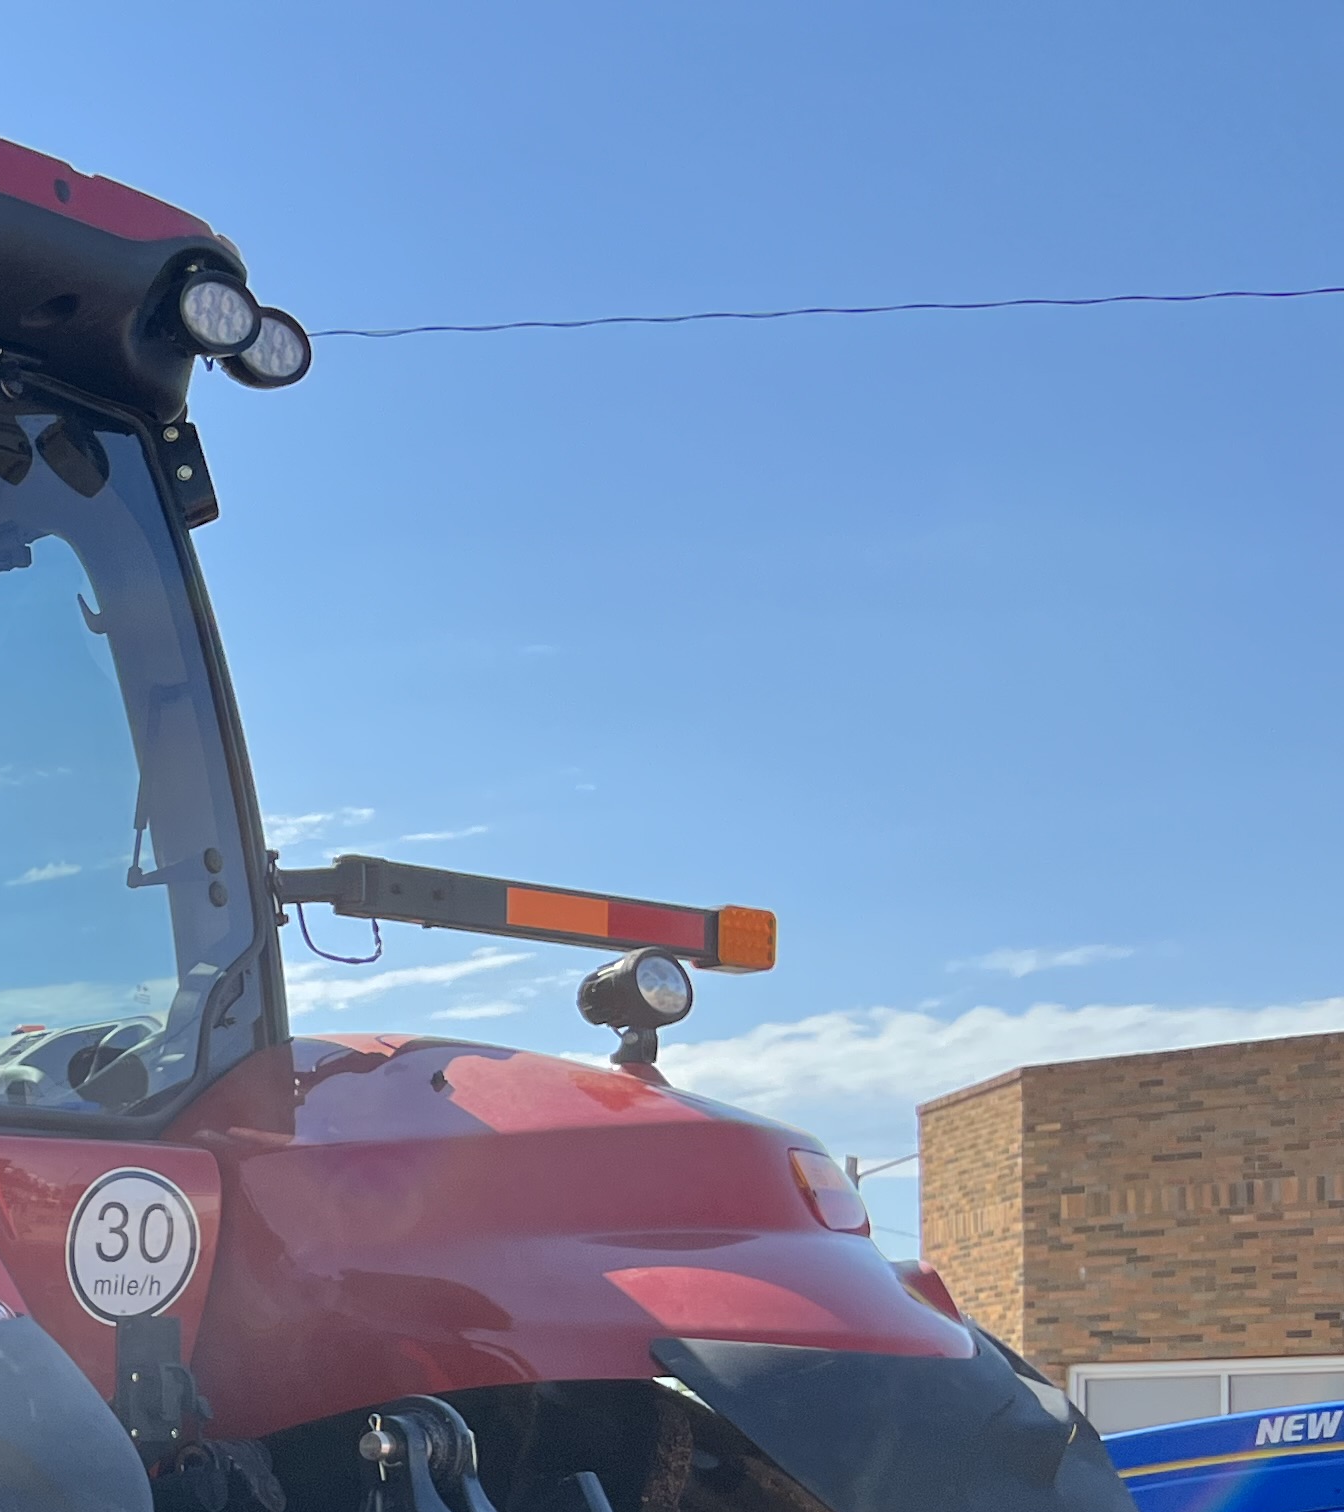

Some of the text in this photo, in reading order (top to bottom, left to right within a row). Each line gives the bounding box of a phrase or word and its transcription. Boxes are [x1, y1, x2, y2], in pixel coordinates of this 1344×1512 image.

[94, 1201, 174, 1264] 30
[93, 1274, 162, 1298] mile/h
[1254, 1409, 1344, 1447] NEW
